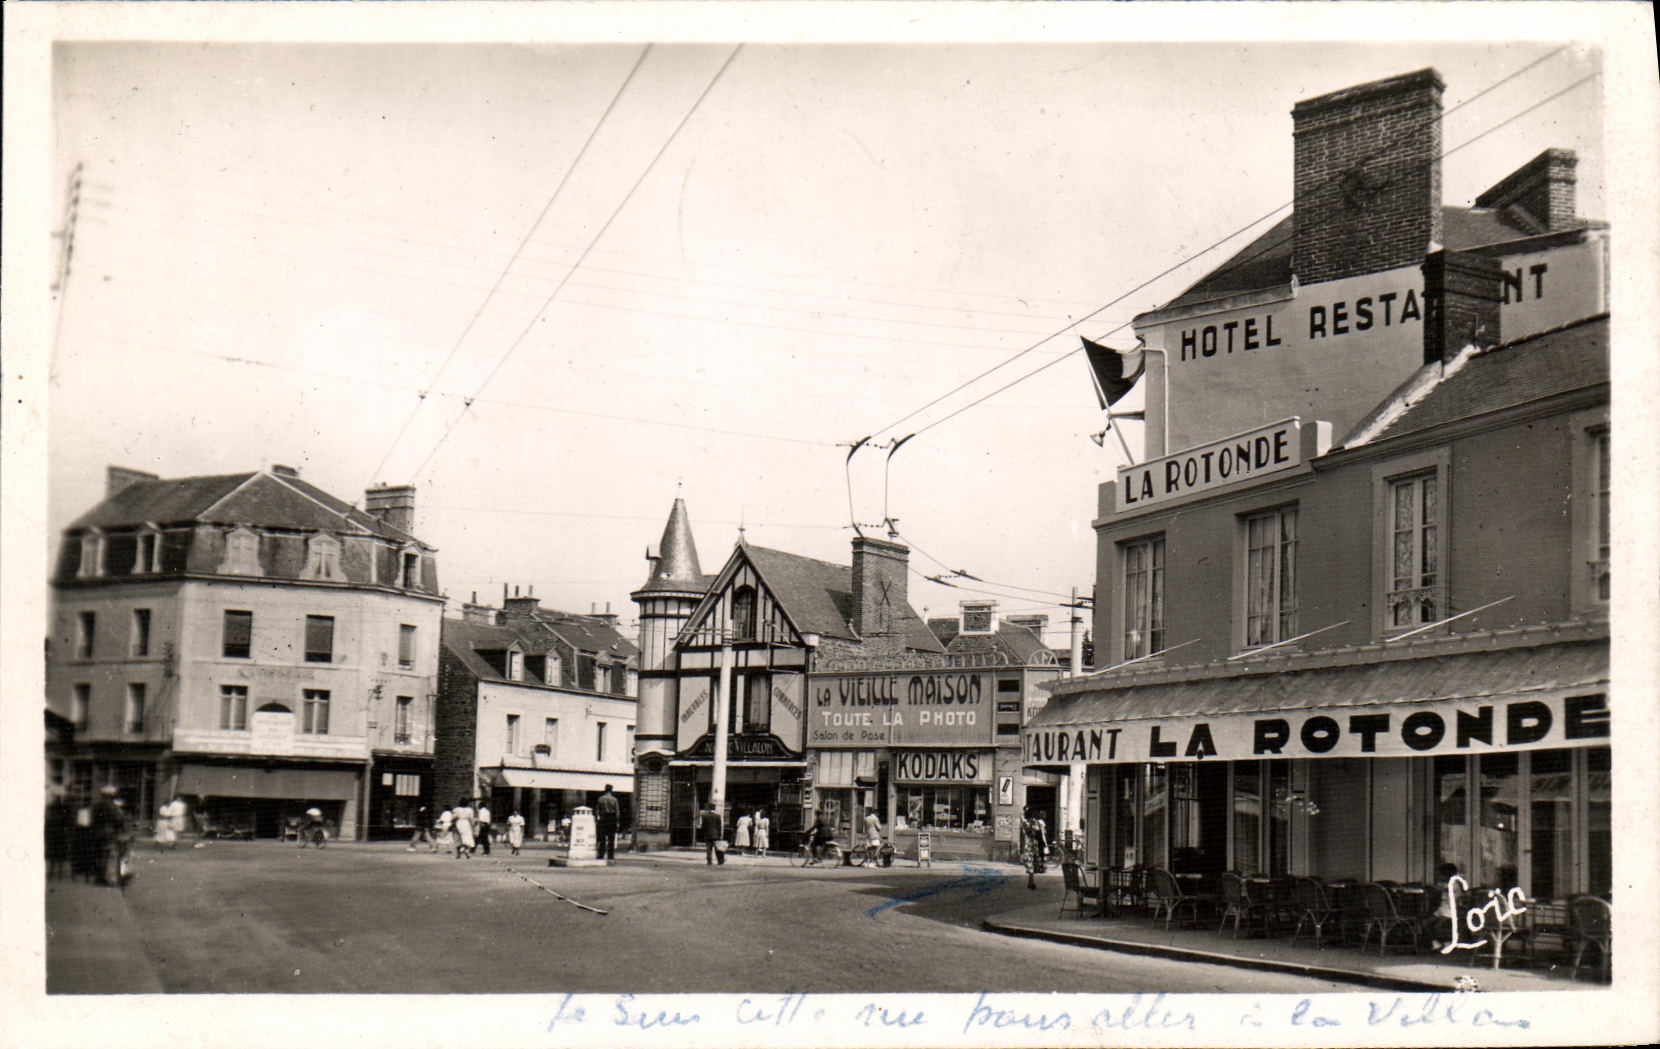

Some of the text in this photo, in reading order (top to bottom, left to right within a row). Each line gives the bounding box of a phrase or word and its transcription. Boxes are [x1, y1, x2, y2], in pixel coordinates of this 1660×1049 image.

[1181, 263, 1548, 361] HOTEL RESTANT
[1125, 430, 1289, 504] LA ROTONDE
[817, 687, 831, 707] LA
[822, 710, 977, 727] TOUTE LA PHOTO
[1149, 723, 1218, 757] LA
[1253, 693, 1611, 754] ROTONDE
[813, 730, 886, 741] Salon de Pose
[898, 753, 978, 779] KODAKS
[1291, 997, 1341, 1028] la
